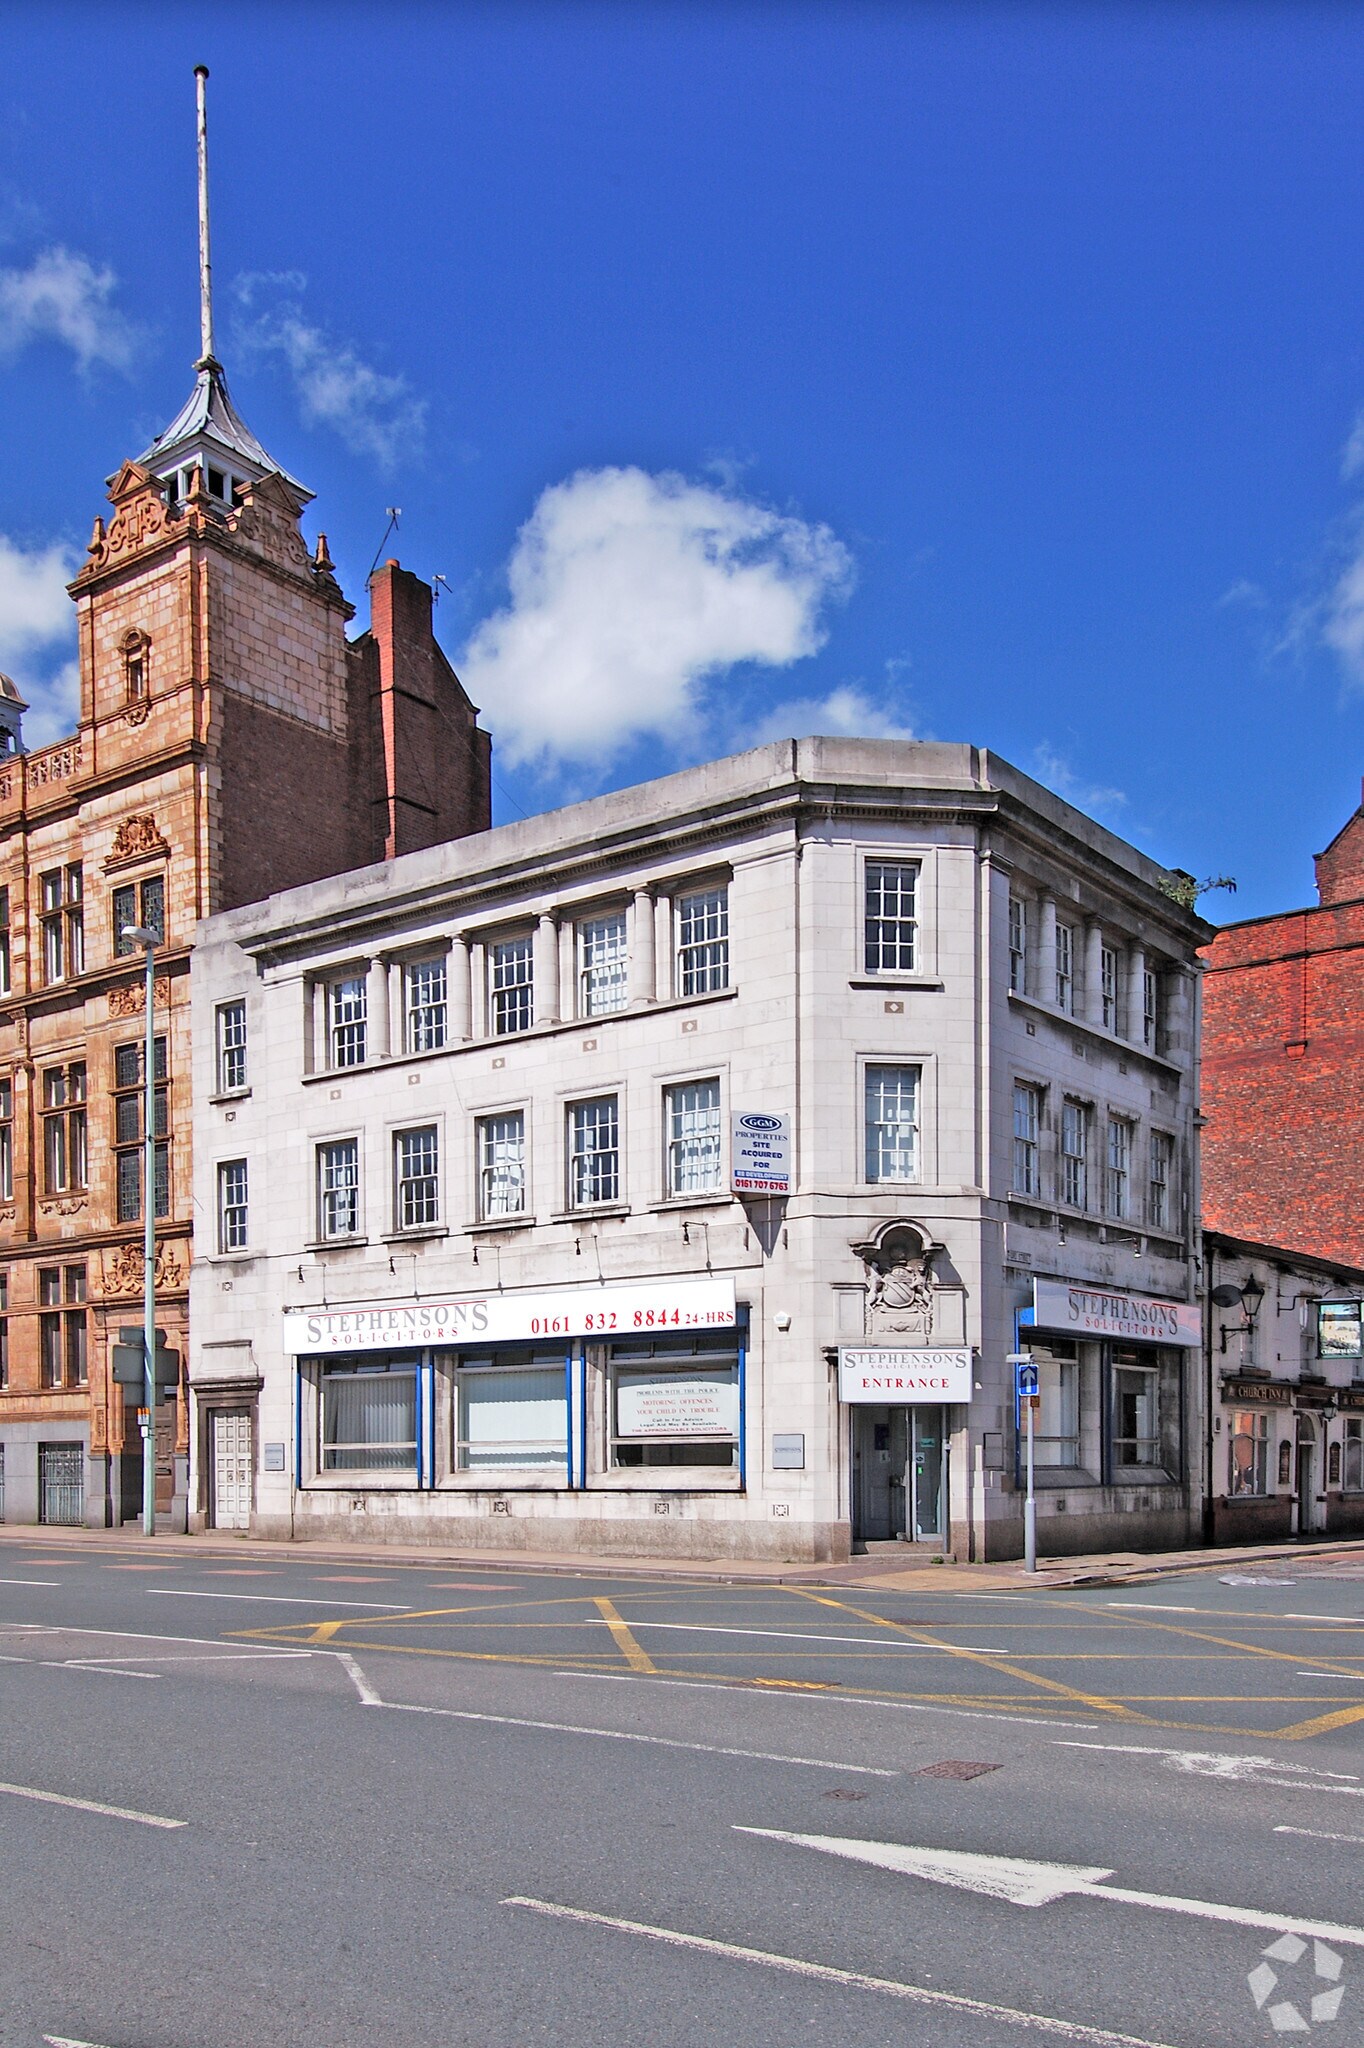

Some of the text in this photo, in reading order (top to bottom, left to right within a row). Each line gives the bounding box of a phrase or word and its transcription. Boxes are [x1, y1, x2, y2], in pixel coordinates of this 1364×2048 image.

[749, 1119, 773, 1127] GGM
[735, 1131, 788, 1141] PROPERTIES
[741, 1149, 783, 1159] ACQUIRED
[753, 1161, 770, 1169] FOR
[754, 1180, 768, 1189] 707
[1068, 1292, 1178, 1335] STEPHENSONS
[307, 1303, 489, 1344] STEPHENSONS
[531, 1316, 570, 1334] 0161
[584, 1312, 617, 1330] 832
[633, 1308, 680, 1327] 8844
[844, 1353, 967, 1368] STEPHENSONS
[862, 1378, 950, 1388] ENTRANCE
[1239, 1386, 1281, 1398] CHURCH INN
